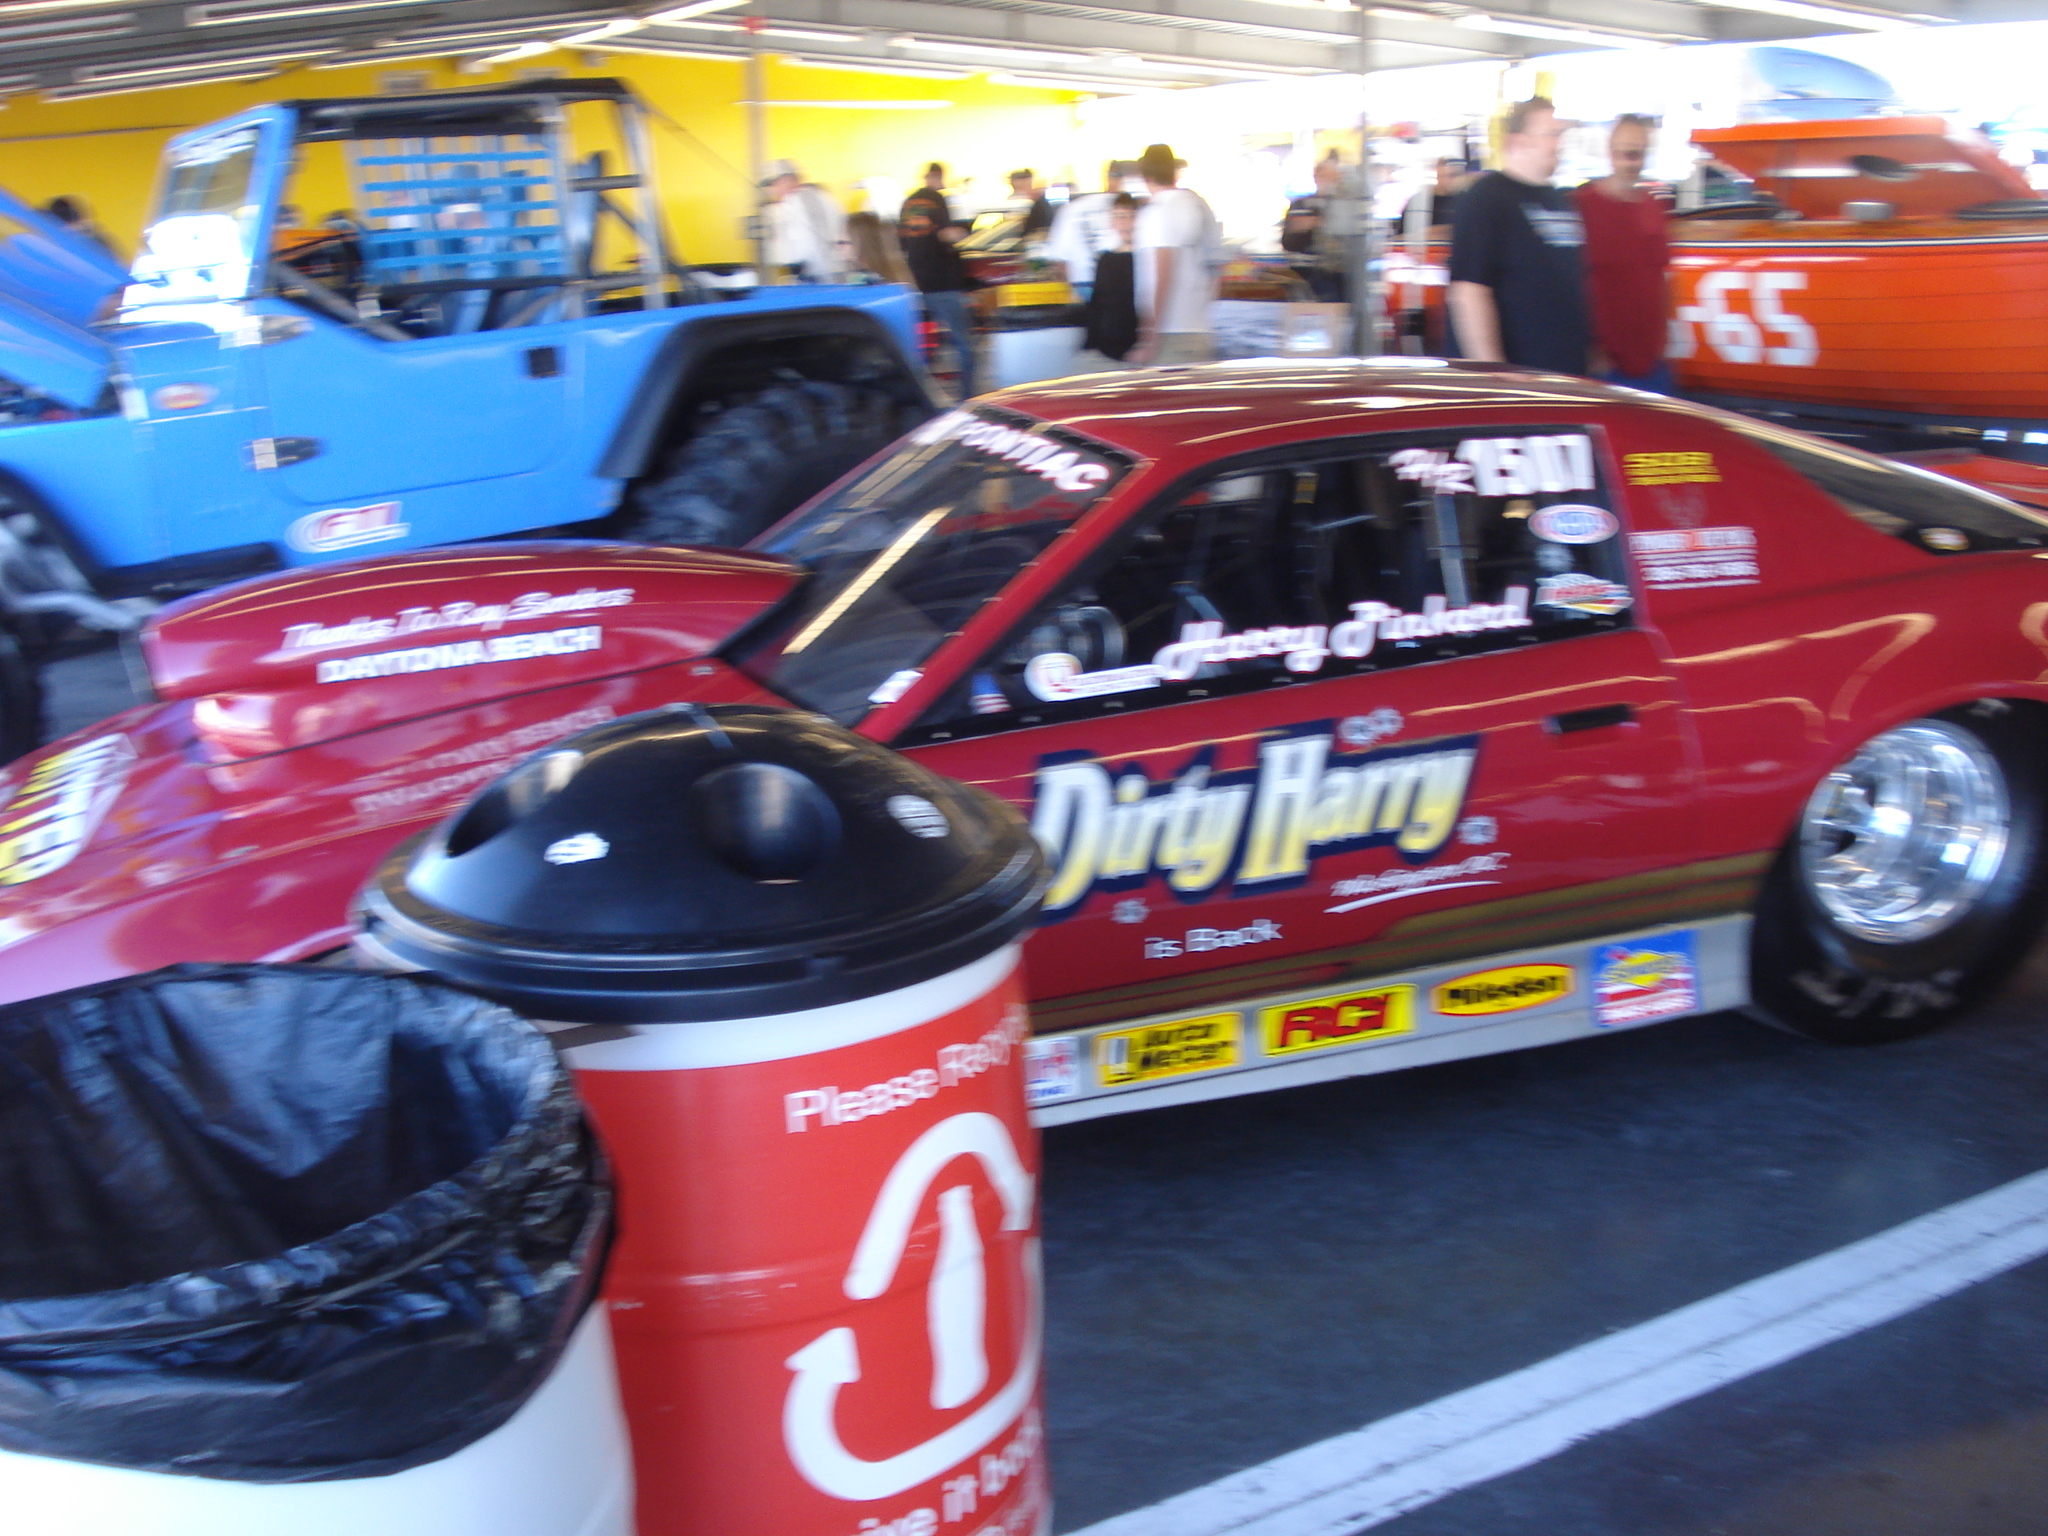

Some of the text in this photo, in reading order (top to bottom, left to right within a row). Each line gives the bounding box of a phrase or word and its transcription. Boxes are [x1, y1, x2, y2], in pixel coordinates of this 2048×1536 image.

[957, 418, 1111, 491] PONTIAC
[316, 624, 603, 684] DAYTONA BEACH
[1153, 620, 1331, 673] Harry
[1030, 730, 1479, 913] Dirty Harry
[1144, 918, 1283, 960] is Back
[783, 1067, 940, 1135] Please
[941, 1473, 979, 1523] it
